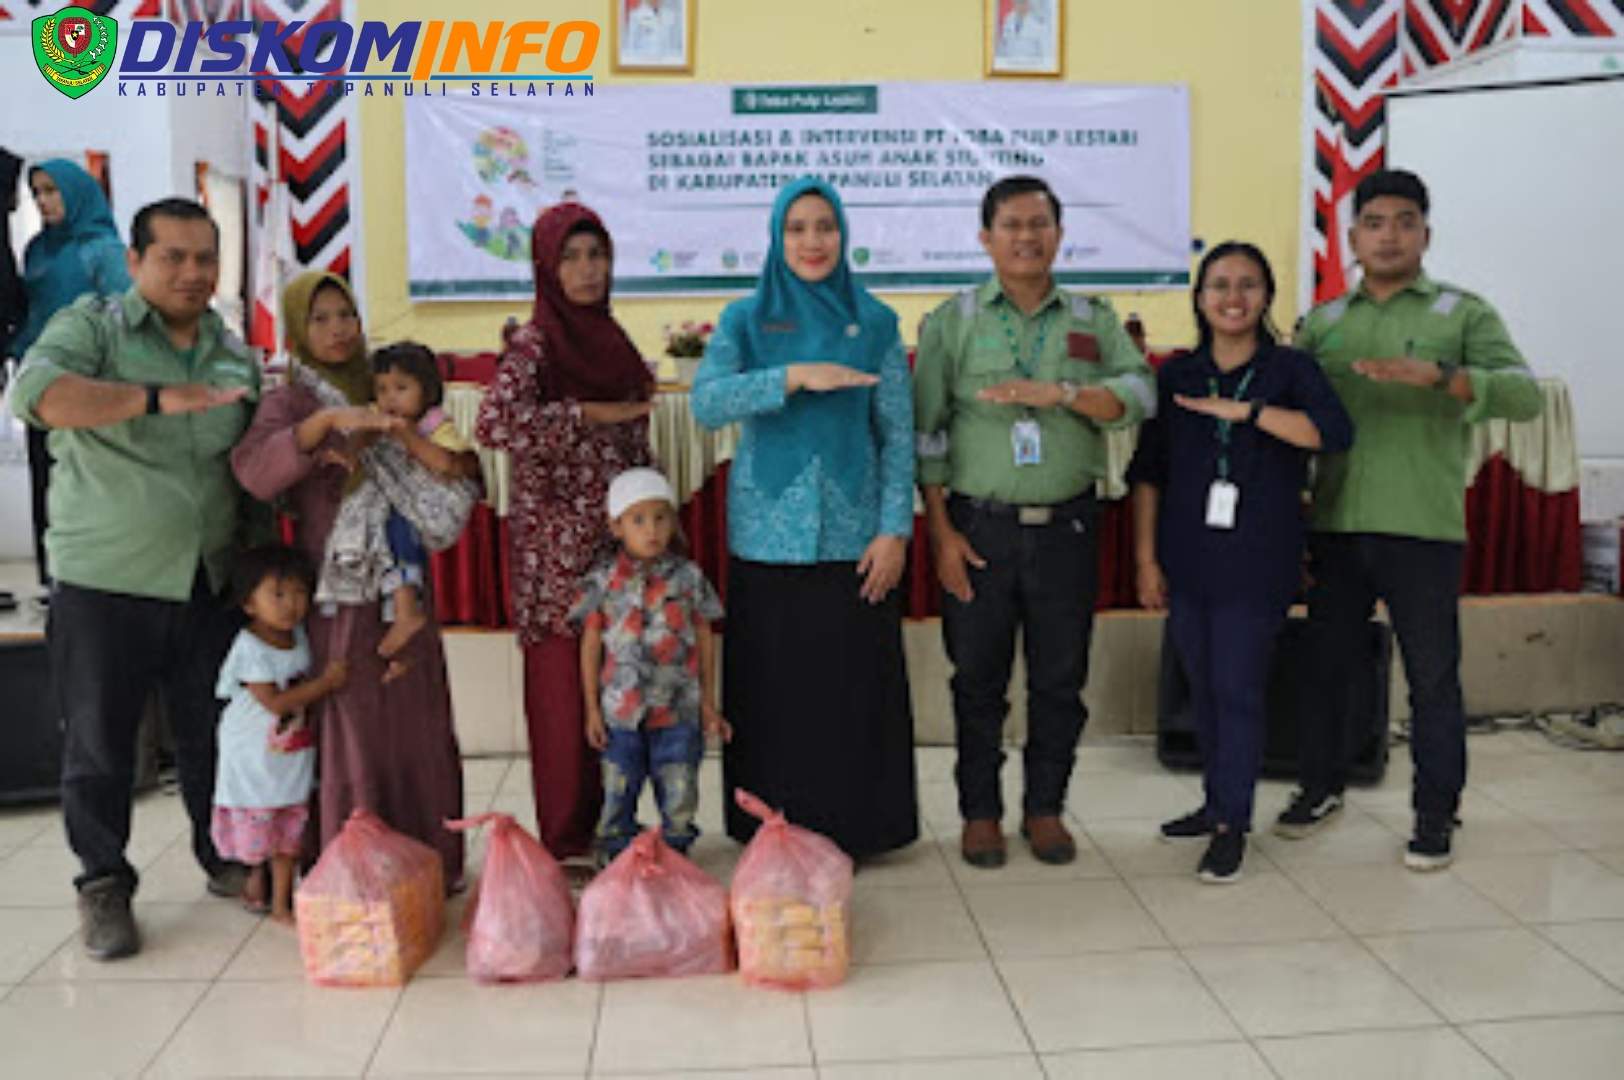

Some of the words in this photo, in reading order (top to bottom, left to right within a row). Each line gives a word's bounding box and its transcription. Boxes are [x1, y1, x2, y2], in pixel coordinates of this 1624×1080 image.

[648, 129, 772, 146] SOSIALISASI
[801, 129, 917, 145] INTERVENSI
[924, 129, 946, 144] PT
[1064, 129, 1138, 146] LESTARI
[648, 152, 735, 168] SEBAGAI
[742, 151, 807, 167] BAPAK
[816, 150, 870, 167] ASUH
[878, 150, 938, 166] ANAK
[648, 174, 668, 190] DI
